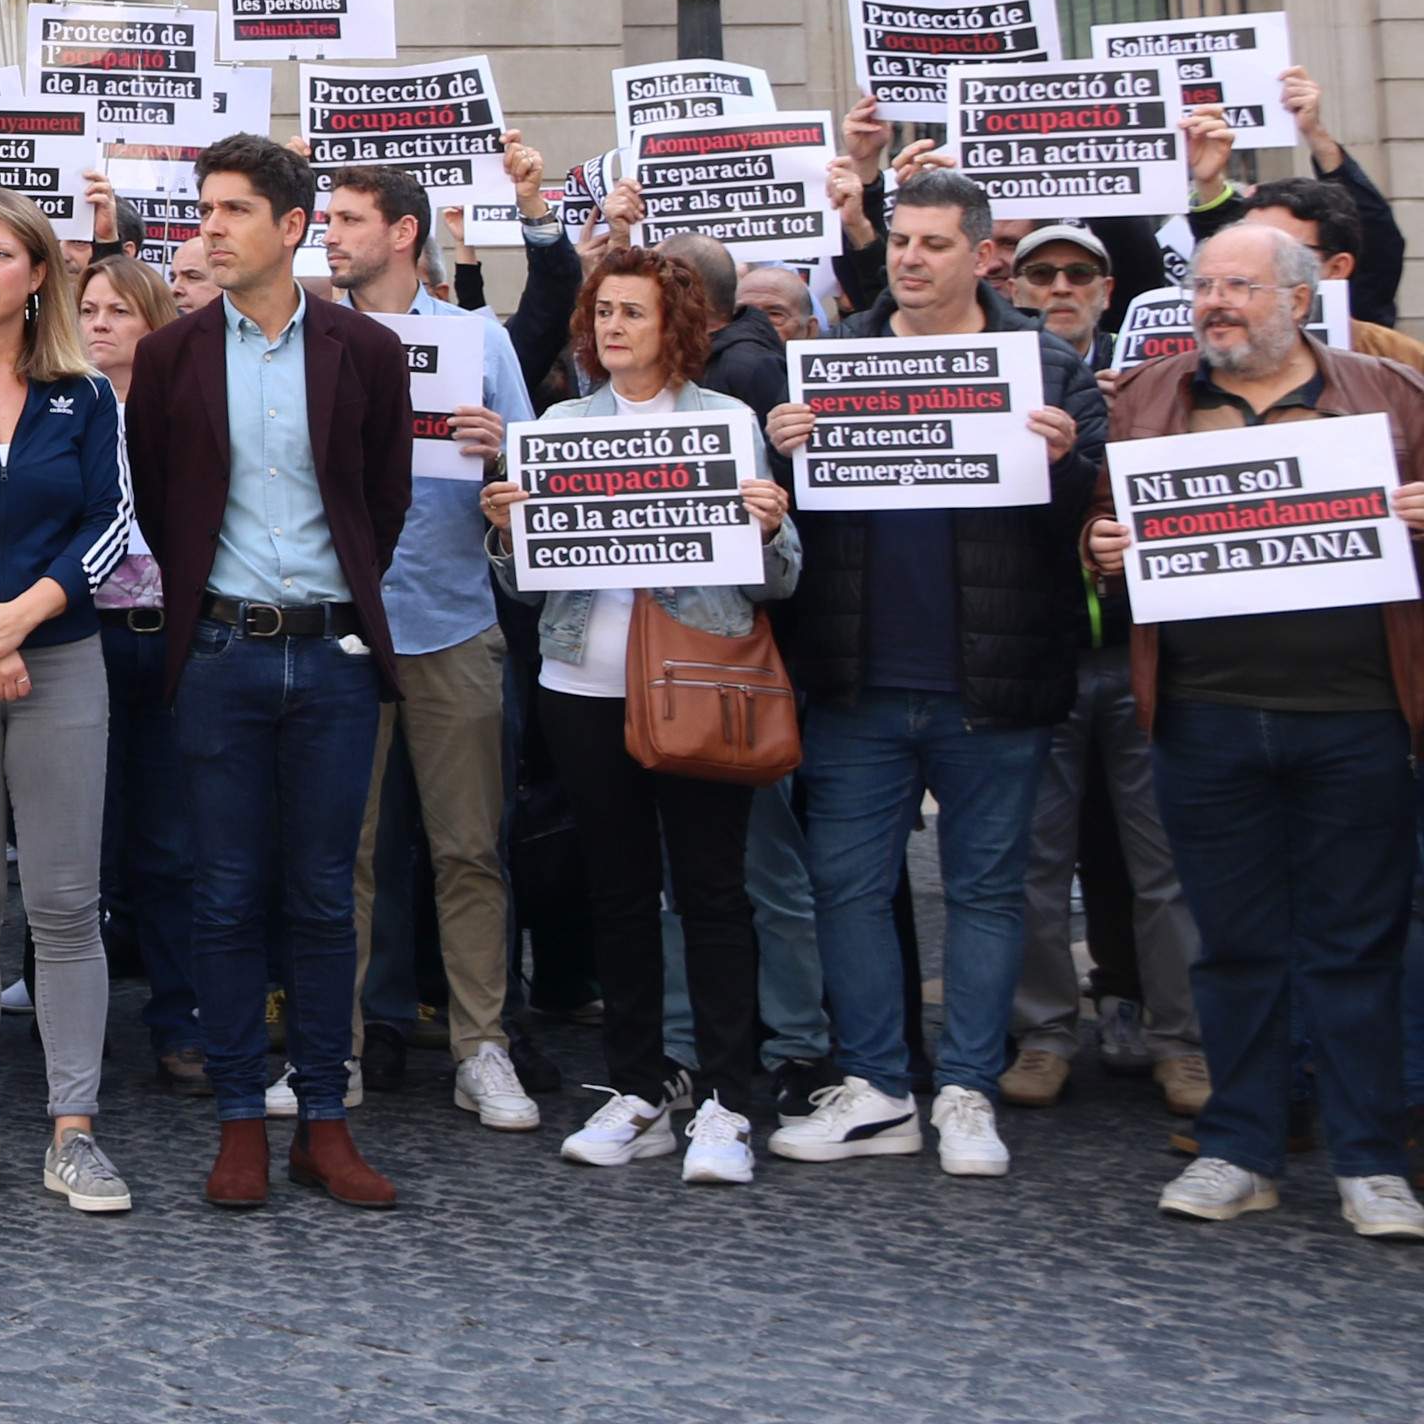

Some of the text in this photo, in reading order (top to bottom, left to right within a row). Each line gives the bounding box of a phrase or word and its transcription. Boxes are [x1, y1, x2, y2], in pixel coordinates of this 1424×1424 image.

[238, 19, 338, 38] voluntàries
[866, 4, 1024, 29] Protecció de
[46, 21, 187, 45] Protecció de
[1004, 31, 1016, 50] i
[1111, 33, 1240, 58] Solidaritat
[168, 50, 177, 70] i
[872, 57, 904, 77] de
[46, 75, 196, 99] de la activitat
[313, 74, 477, 104] Protecció de
[630, 73, 742, 100] Solidaritat
[965, 75, 1107, 104] Protecció
[1113, 72, 1152, 97] de
[460, 102, 471, 124] i
[632, 99, 718, 125] amb les
[1126, 102, 1140, 126] i
[314, 132, 497, 161] de la activitat
[642, 126, 822, 156] Acompanyament
[967, 137, 1169, 167] de la activitat
[24, 168, 52, 186] ho
[641, 156, 769, 187] i reparació
[154, 204, 180, 218] un
[476, 206, 512, 222] per
[645, 186, 797, 218] per als qui ho
[697, 215, 816, 240] perdut tot
[807, 351, 990, 383] Agraïment als
[809, 387, 1004, 415] serveis públics
[526, 428, 721, 463] Protecció de
[811, 423, 947, 448] i d'atenció
[696, 462, 710, 487] i
[814, 457, 990, 486] d'emergències
[1132, 460, 1293, 504] Ni un sol
[531, 499, 740, 532] de la activitat
[1142, 490, 1386, 539] acomiadament
[534, 537, 705, 566] econòmica
[1146, 529, 1374, 579] per la DANA
